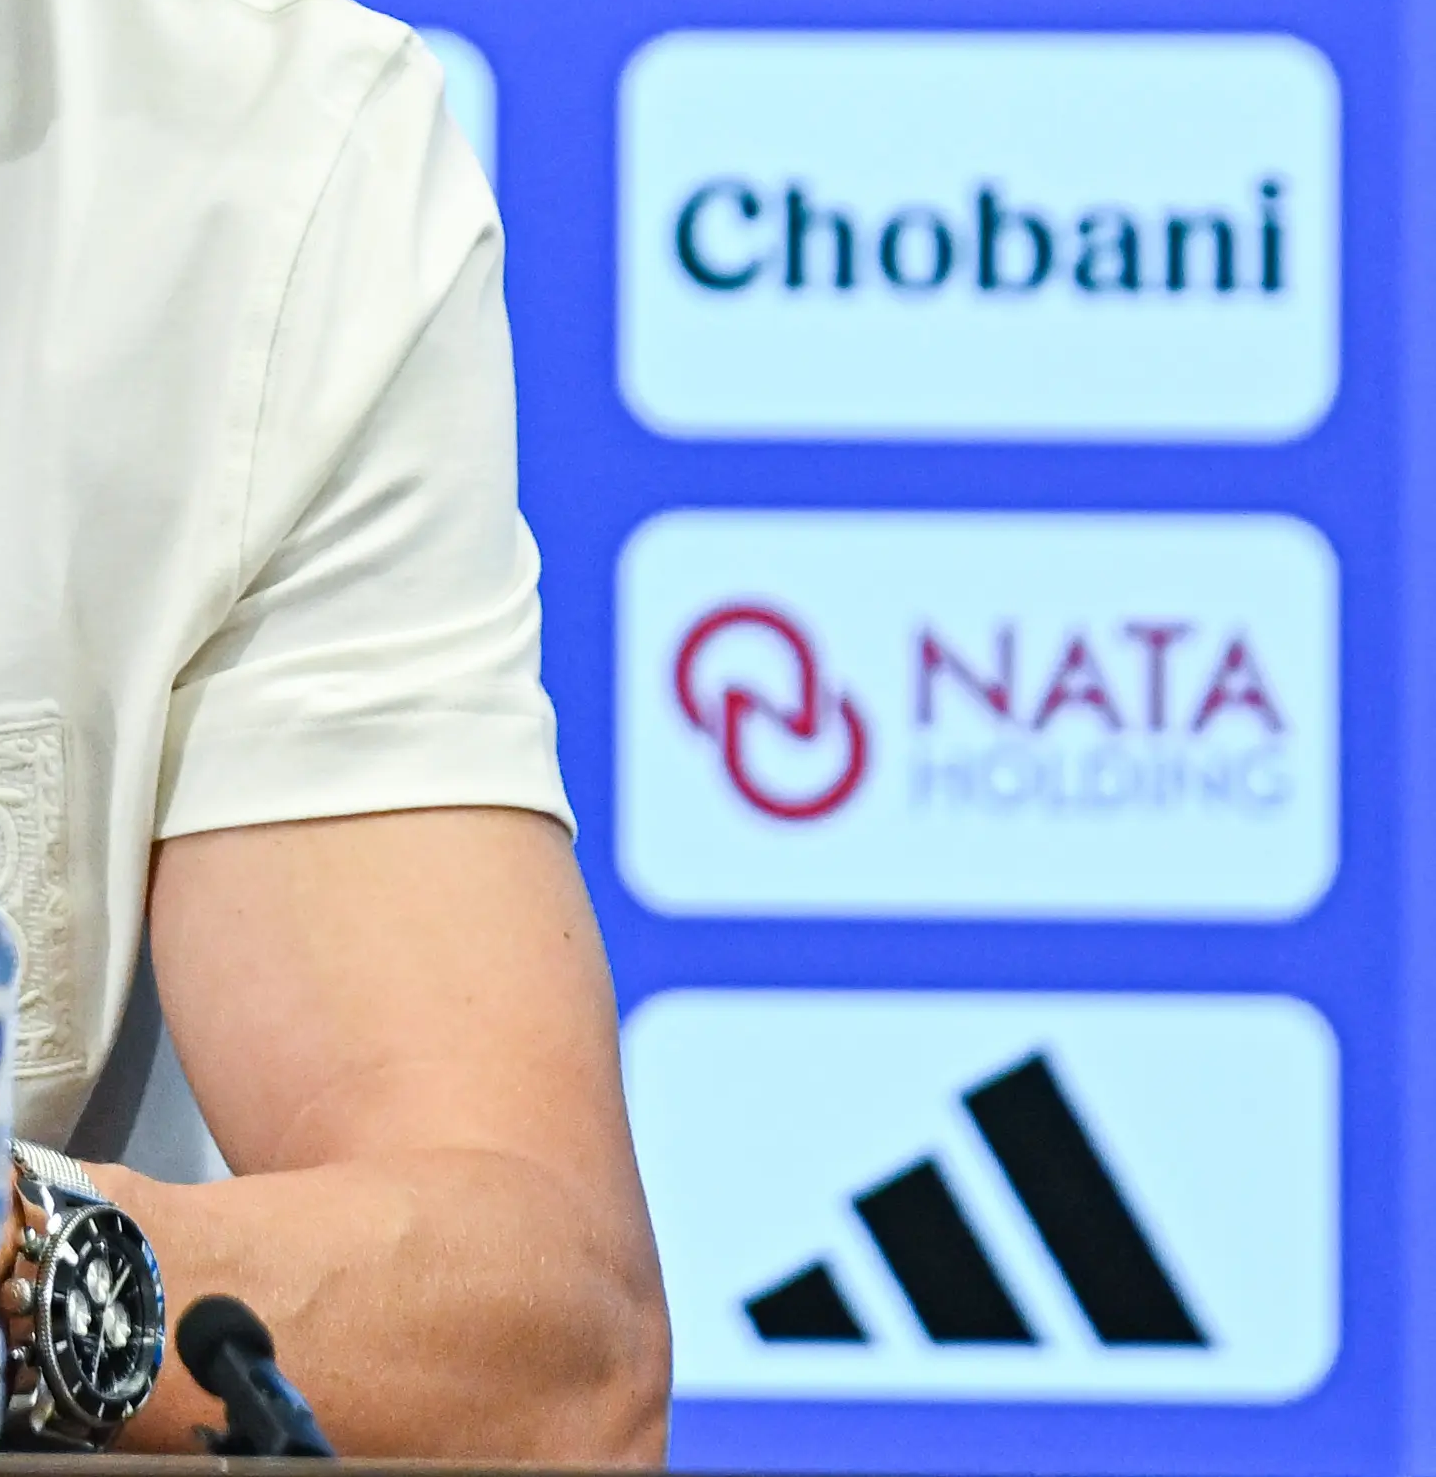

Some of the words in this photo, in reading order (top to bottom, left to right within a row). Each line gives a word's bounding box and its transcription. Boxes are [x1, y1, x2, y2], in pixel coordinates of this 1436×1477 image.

[671, 178, 1285, 294] Chobani
[914, 619, 1287, 734] NATA
[917, 744, 1292, 812] HOLDING
